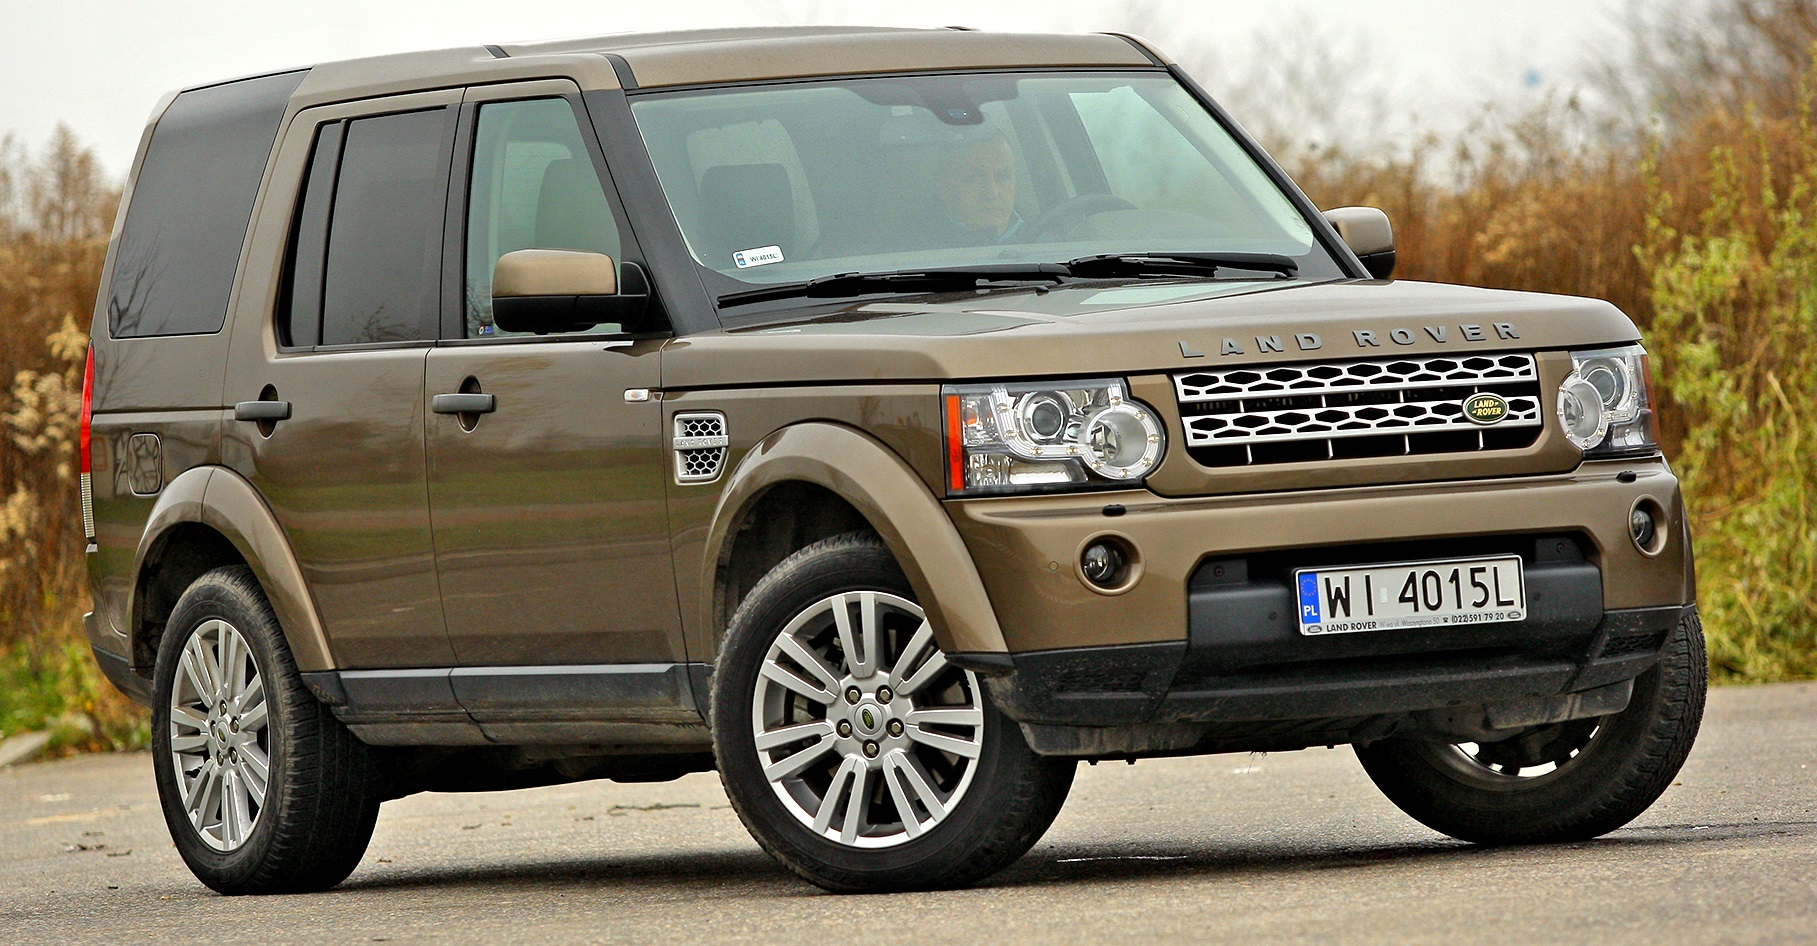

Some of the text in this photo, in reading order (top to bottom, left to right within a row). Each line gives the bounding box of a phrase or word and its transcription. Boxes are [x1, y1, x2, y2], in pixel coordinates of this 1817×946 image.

[1178, 322, 1520, 358] LAND ROVER
[1474, 400, 1494, 408] LAND
[1477, 407, 1501, 416] ROVER
[1324, 565, 1515, 619] WI 4015L
[1303, 605, 1318, 617] PL
[1326, 623, 1348, 632] LAND
[1351, 621, 1377, 631] ROVER
[1495, 612, 1504, 620] 20
